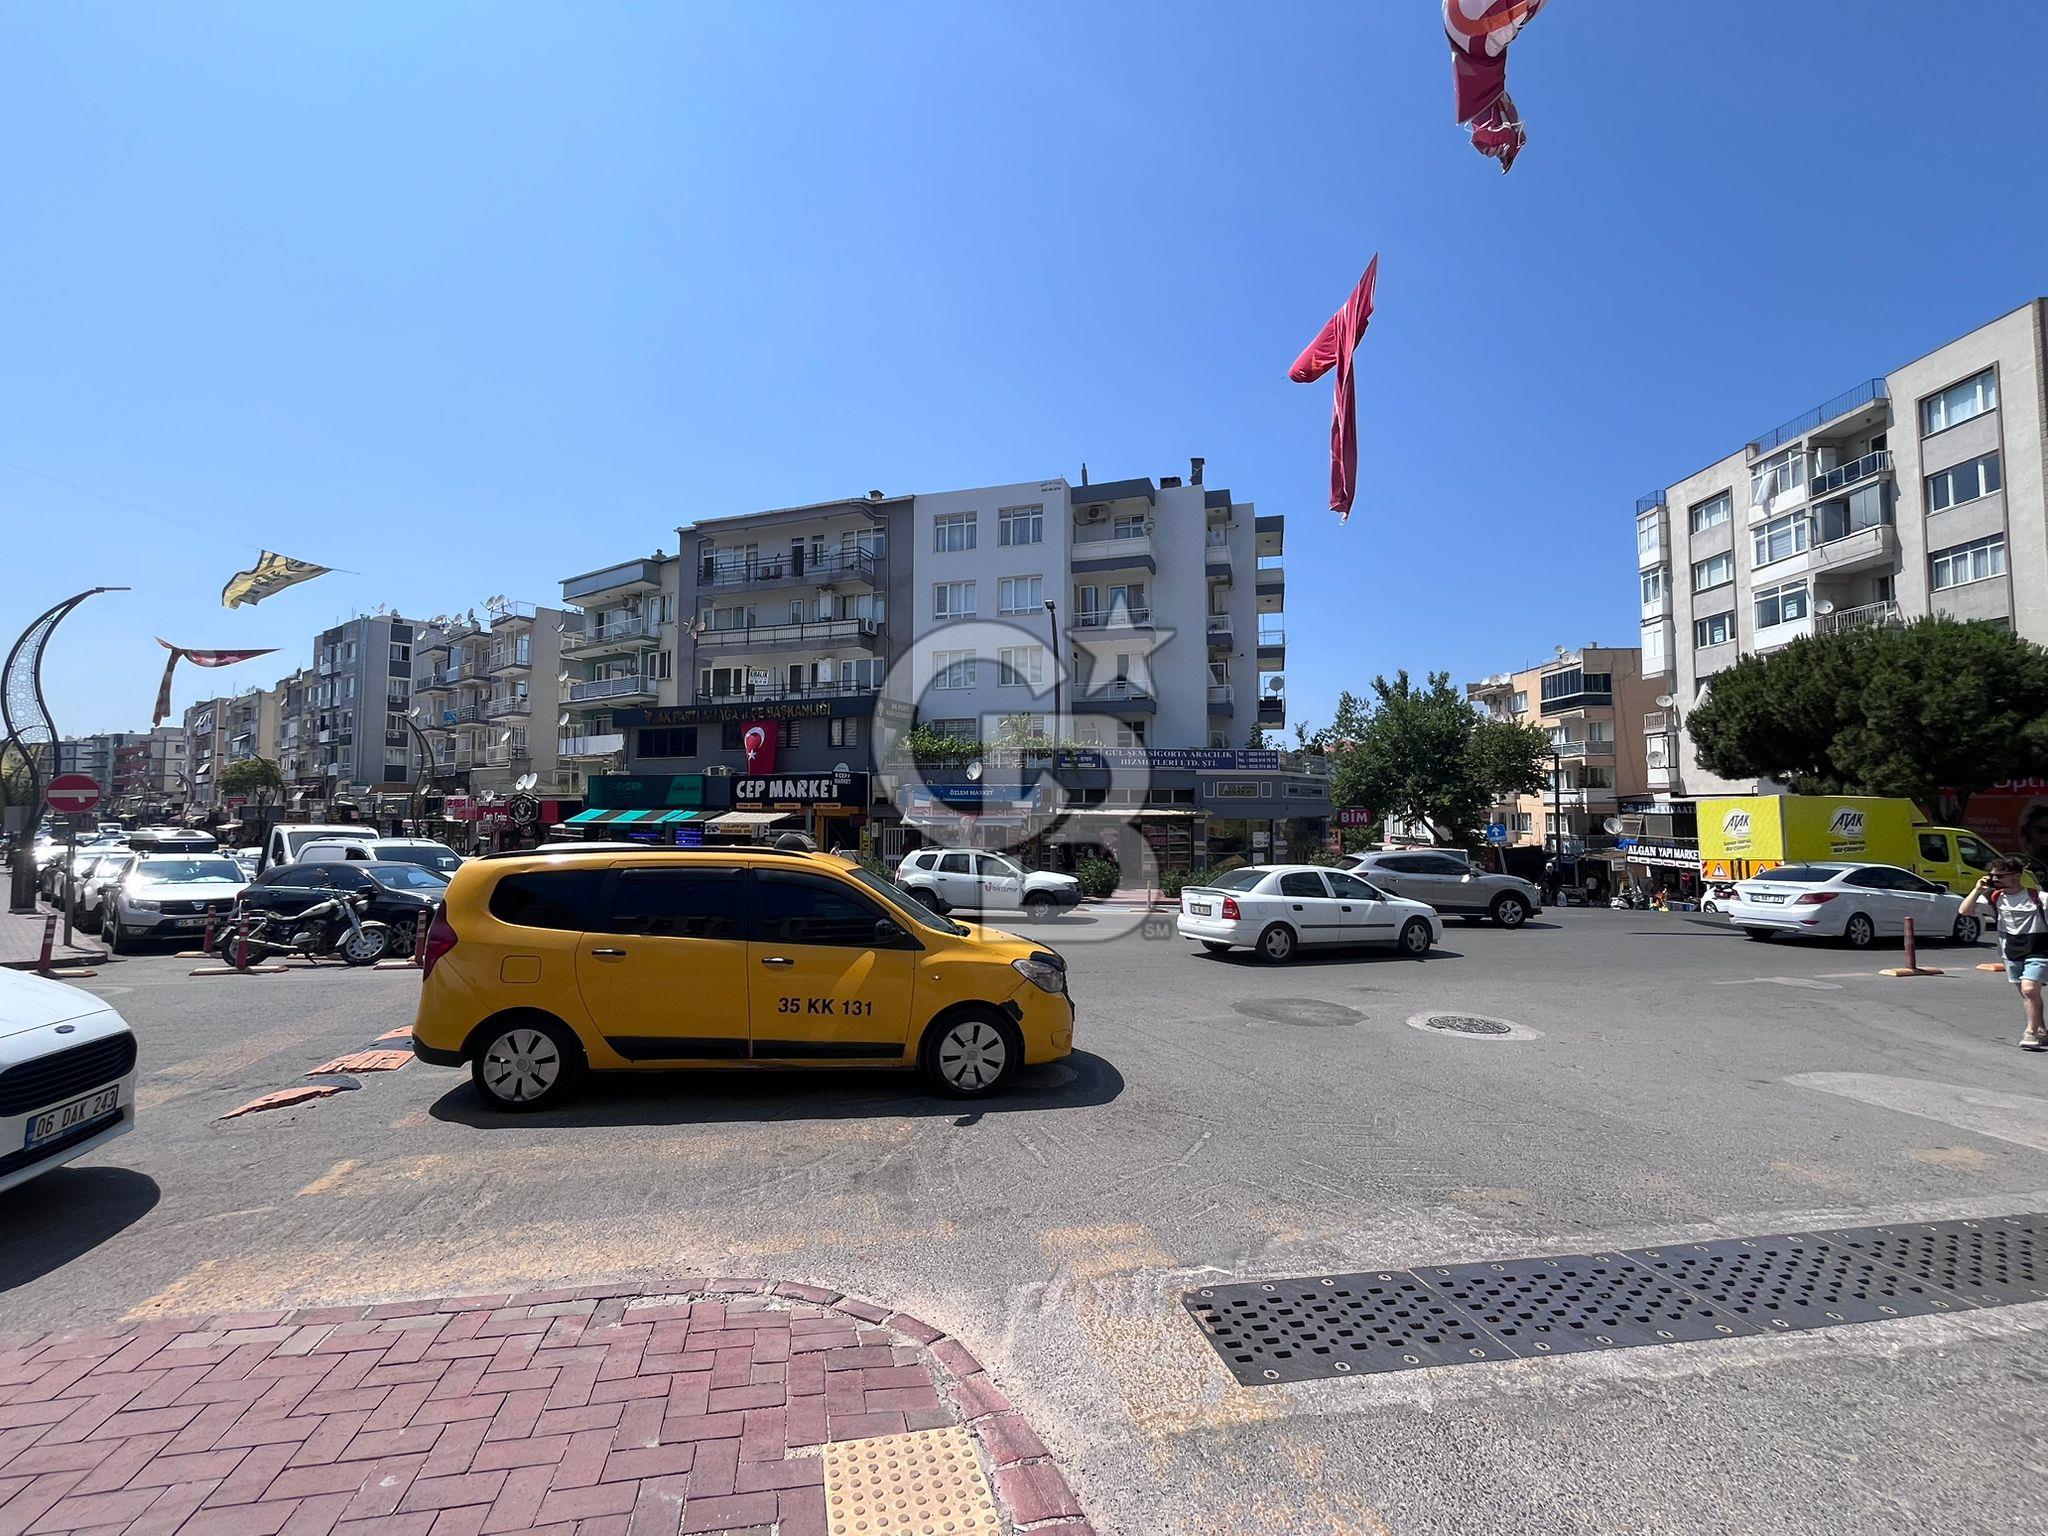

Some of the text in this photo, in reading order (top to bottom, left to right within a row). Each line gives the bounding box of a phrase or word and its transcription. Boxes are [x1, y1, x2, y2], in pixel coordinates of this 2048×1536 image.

[1148, 749, 1187, 758] SİGORTA
[736, 779, 838, 798] CEP MARKET
[1340, 809, 1368, 823] BİM
[1723, 814, 1750, 832] ATAK
[1829, 813, 1864, 832] ATAK
[1628, 844, 1699, 860] ALGAN YAPI MARKE
[778, 997, 872, 1016] 35 KK 131
[37, 1090, 115, 1137] 06 DAK 243
